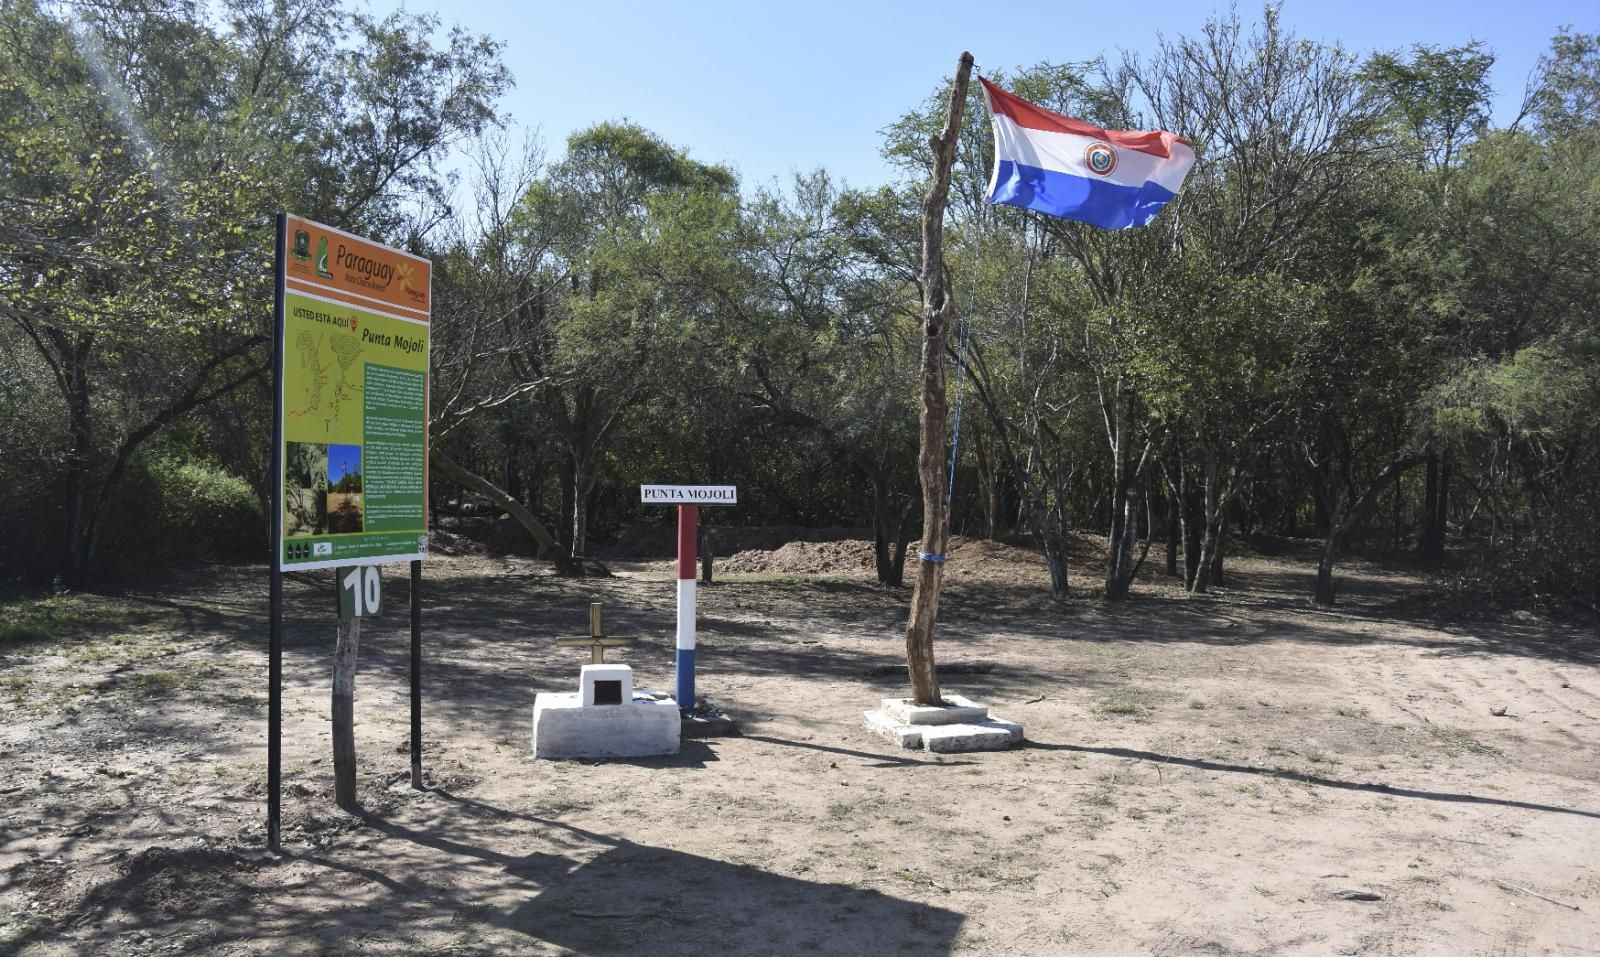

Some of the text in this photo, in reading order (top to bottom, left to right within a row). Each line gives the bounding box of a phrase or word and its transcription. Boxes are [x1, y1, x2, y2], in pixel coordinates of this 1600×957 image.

[336, 244, 396, 286] Paraguay
[293, 306, 314, 320] USTED
[362, 328, 425, 354] Punta Mojoli
[644, 488, 734, 500] PUNTA MOJOLI
[343, 566, 381, 617] 10
